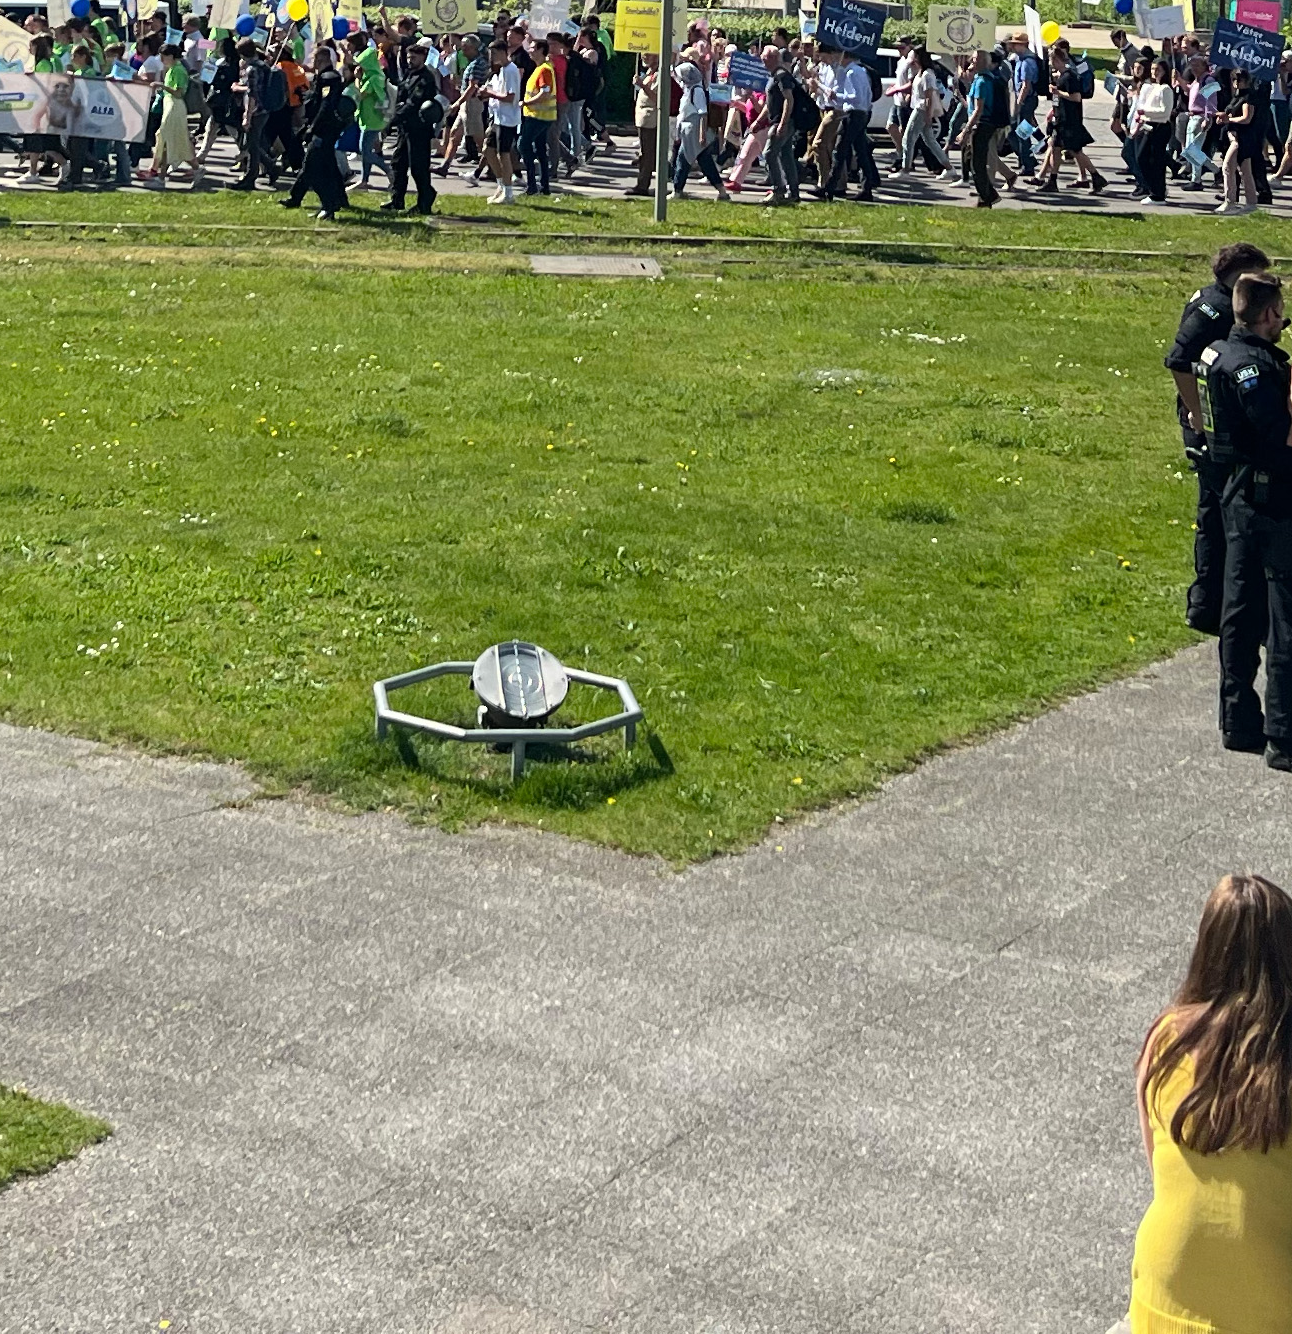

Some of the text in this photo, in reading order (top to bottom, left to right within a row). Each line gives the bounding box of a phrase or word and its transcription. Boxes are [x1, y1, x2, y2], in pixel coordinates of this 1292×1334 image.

[824, 17, 876, 47] Helden!
[1236, 23, 1264, 39] Väter
[1218, 41, 1276, 70] Helden!
[91, 105, 115, 116] ALFA
